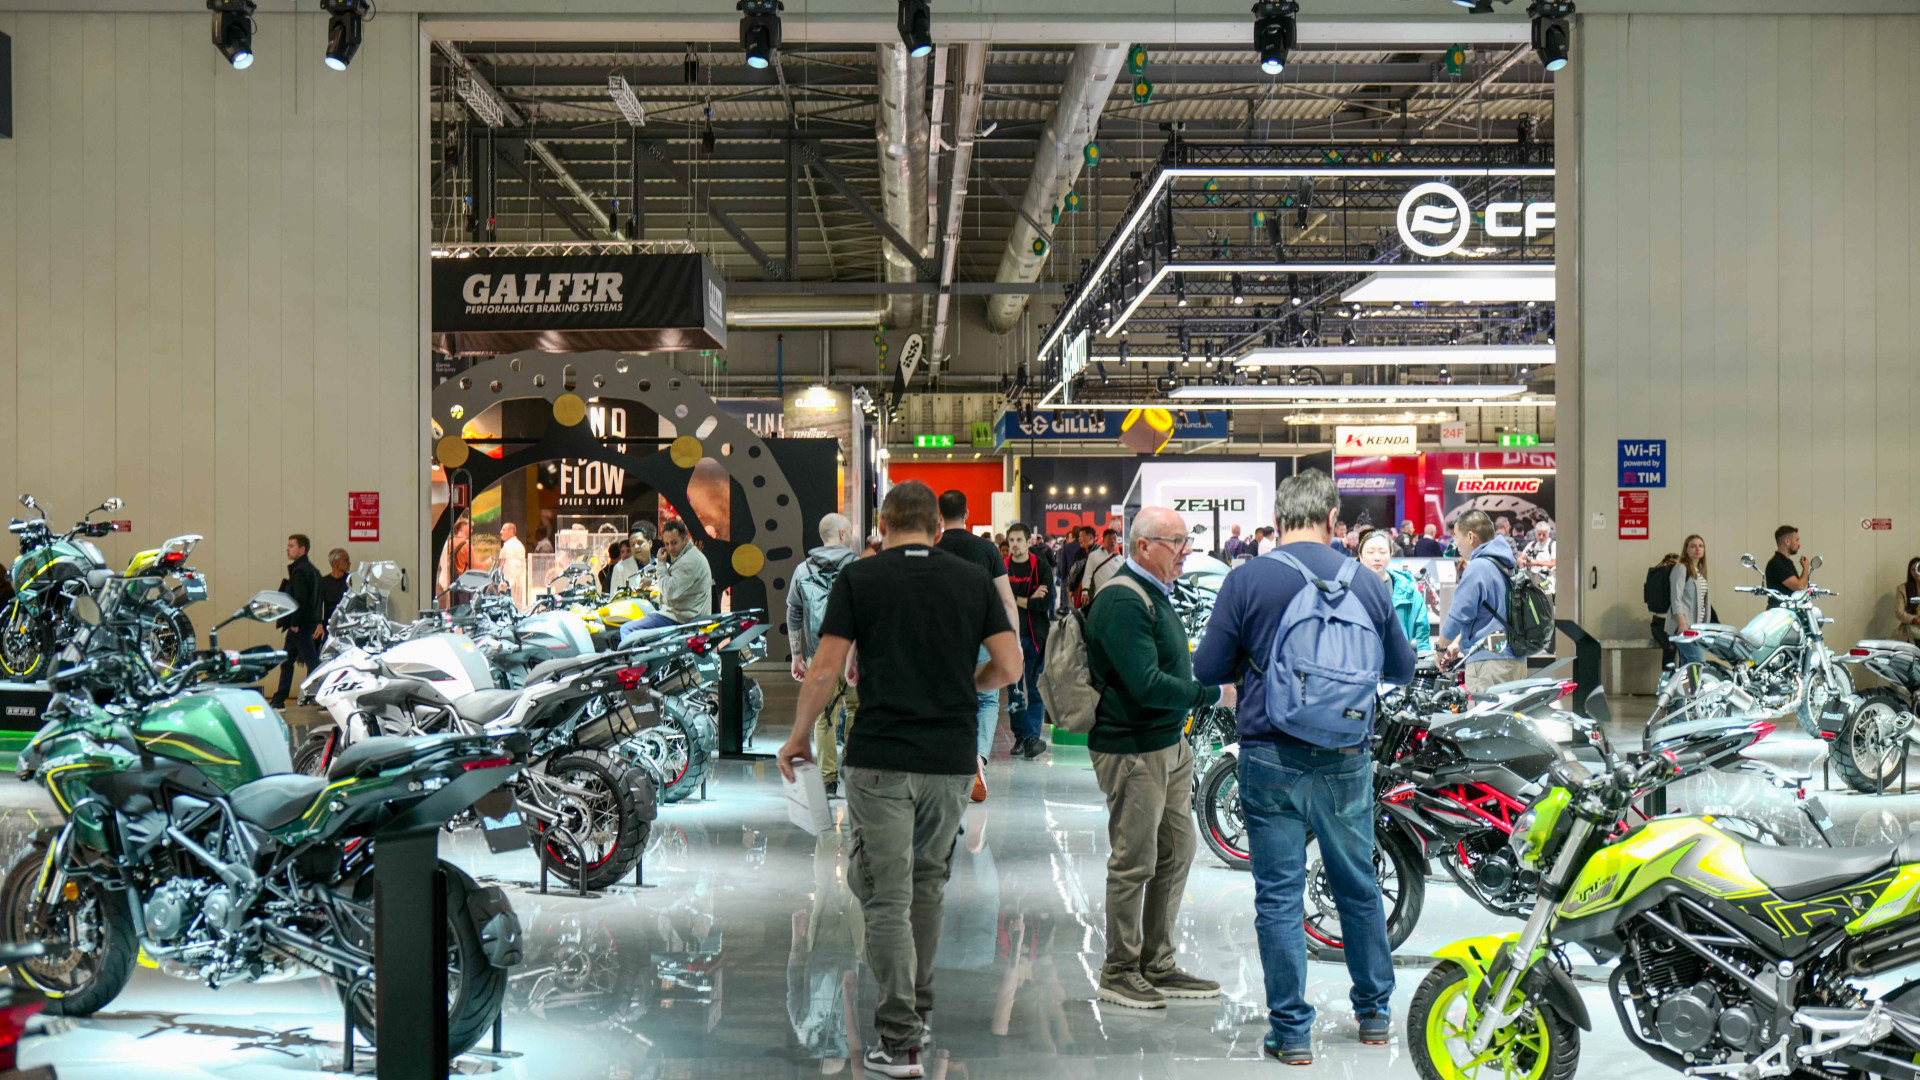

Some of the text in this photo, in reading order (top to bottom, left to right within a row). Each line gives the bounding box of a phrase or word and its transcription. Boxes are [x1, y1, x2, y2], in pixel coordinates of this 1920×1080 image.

[463, 272, 623, 305] GALFER
[465, 302, 623, 315] PERFORMANCE BRAKING SYSTEMS
[1442, 428, 1464, 439] 24F
[1366, 436, 1410, 445] KENDA
[1624, 444, 1661, 456] Wi-Fi
[1624, 459, 1660, 468] powered by
[560, 461, 625, 495] FLOW
[1637, 472, 1661, 483] TIM
[1457, 480, 1539, 492] BRAKING
[1045, 503, 1082, 511] MOBILIZE
